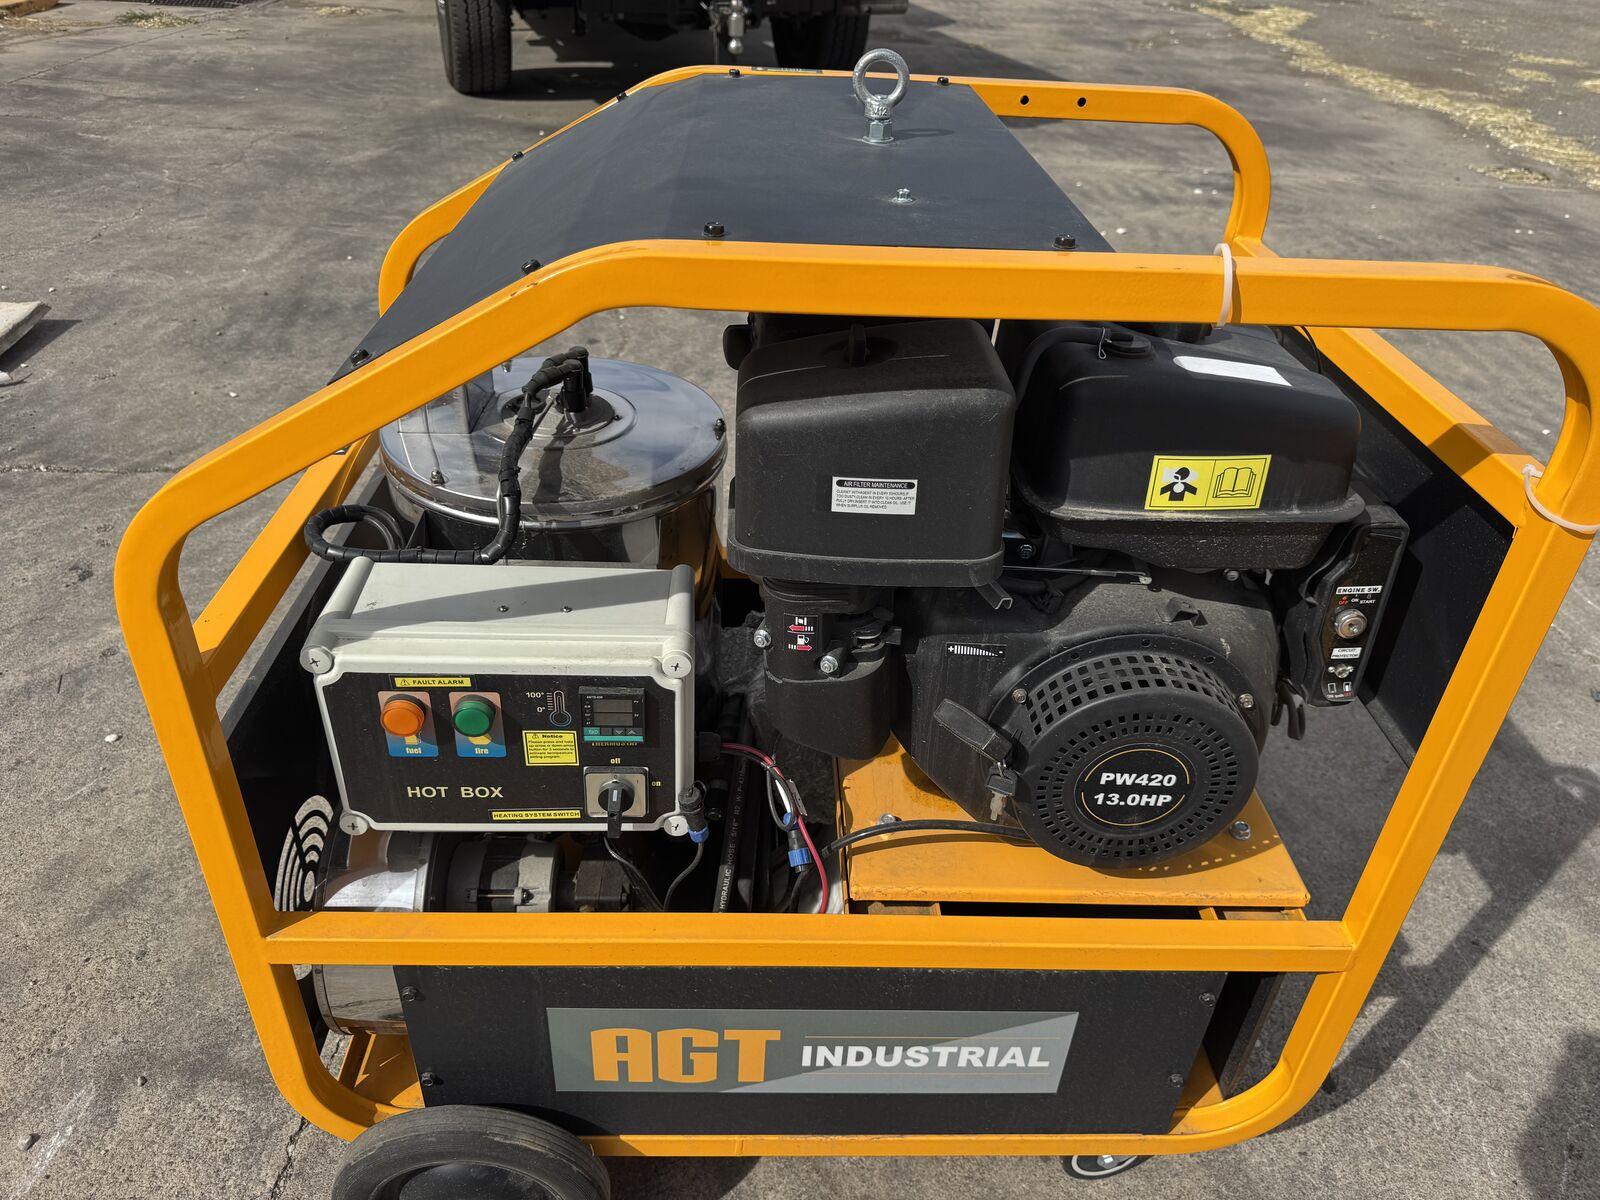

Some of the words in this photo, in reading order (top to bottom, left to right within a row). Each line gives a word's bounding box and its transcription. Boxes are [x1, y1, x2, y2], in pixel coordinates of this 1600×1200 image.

[1100, 772, 1177, 786] PW420
[407, 786, 448, 798] HOT
[460, 786, 504, 798] BOX
[1094, 793, 1172, 806] 13.0HP
[720, 869, 732, 909] HYDRAULIC
[590, 1028, 781, 1082] AGT
[801, 1045, 1050, 1067] INDUSTRIAL
